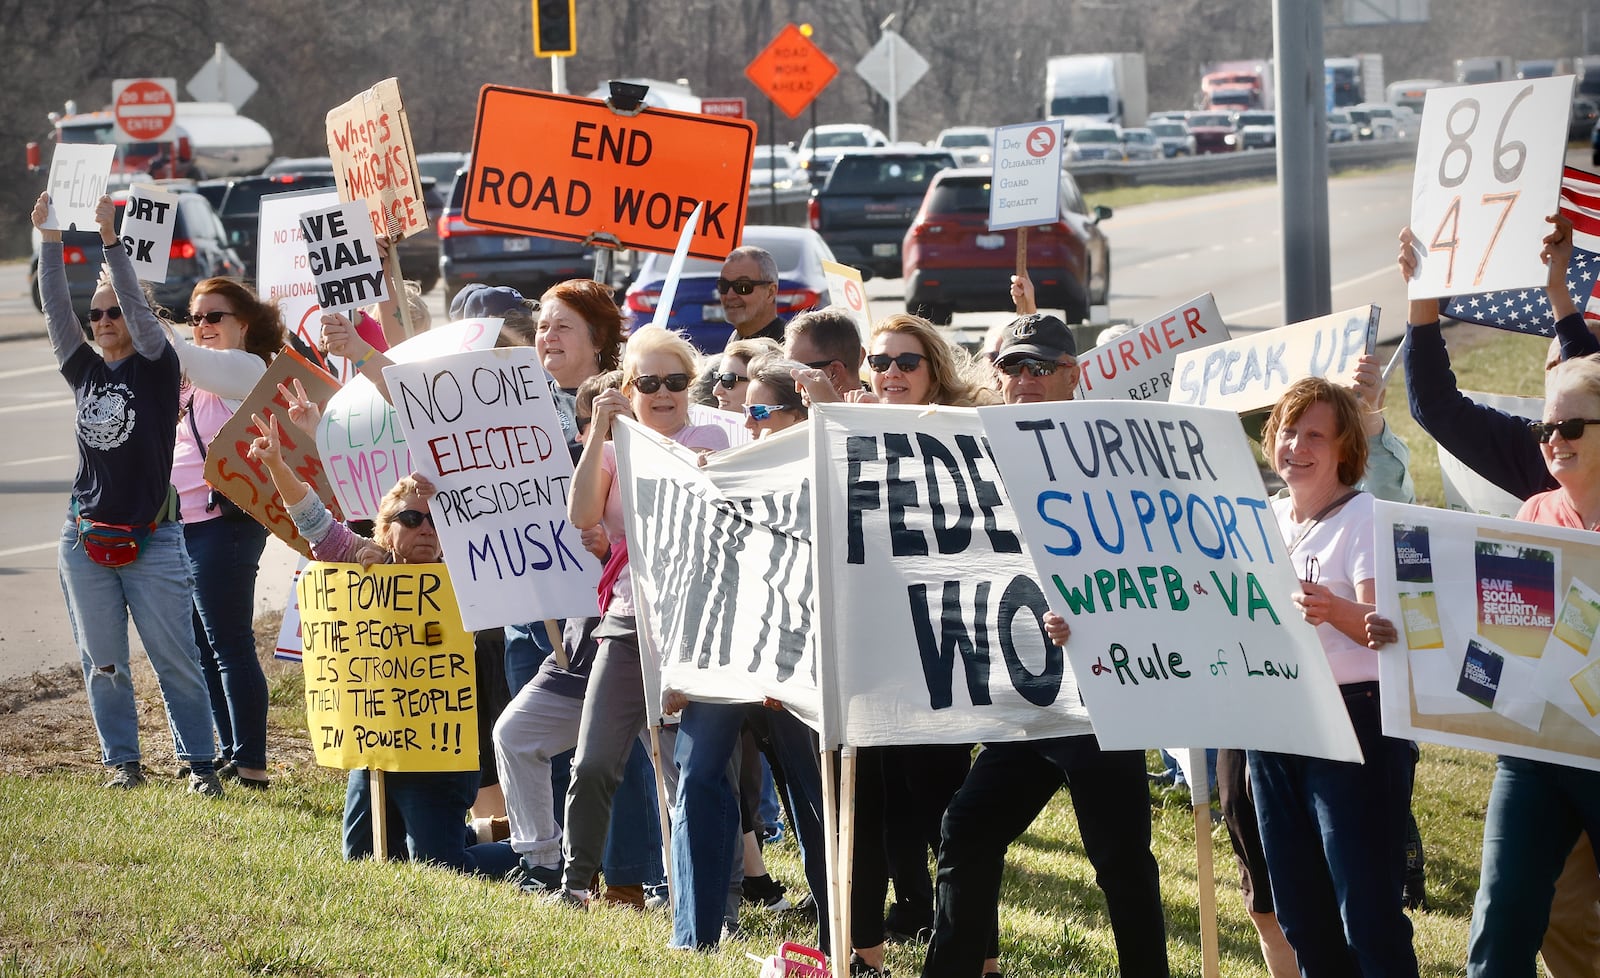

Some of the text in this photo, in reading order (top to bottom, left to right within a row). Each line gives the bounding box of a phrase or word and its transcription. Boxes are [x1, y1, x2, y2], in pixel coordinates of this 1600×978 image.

[774, 47, 808, 57] ROAD
[775, 65, 808, 74] WORK
[121, 90, 166, 103] DO NOT
[772, 81, 814, 92] AHEAD
[704, 103, 740, 114] WRONG
[127, 118, 163, 131] ENTER
[1438, 84, 1534, 188] 86
[352, 146, 370, 164] the
[571, 121, 652, 166] END
[1001, 158, 1047, 169] OLIGARCHY
[1000, 178, 1029, 189] GUARD
[478, 166, 729, 240] ROAD WORK
[999, 197, 1039, 209] EQUALITY
[274, 228, 308, 244] NO TA
[1428, 190, 1522, 288] 47
[294, 255, 309, 269] FO
[1079, 306, 1207, 391] TURNER
[1180, 317, 1369, 405] SPEAK UP
[399, 365, 539, 430] NO ONE
[1128, 368, 1174, 400] REPR
[428, 425, 552, 477] ELECTED
[1015, 418, 1218, 481] TURNER
[435, 475, 570, 527] PRESIDENT
[846, 432, 1023, 565] FEDE
[1037, 489, 1275, 564] SUPPORT
[468, 520, 583, 581] MUSK
[301, 568, 338, 612] THE
[346, 569, 441, 616] POWER
[1051, 565, 1189, 616] WPAFB
[1209, 570, 1281, 625] VA
[1480, 578, 1513, 592] SAVE
[1482, 590, 1525, 604] SOCIAL
[1483, 602, 1538, 616] SECURITY
[1484, 614, 1492, 625] &
[356, 619, 443, 650] PEOPLE
[907, 574, 1085, 710] WO
[316, 653, 470, 682] IS STRONGER
[1210, 648, 1228, 676] of
[1239, 641, 1299, 680] Law
[308, 686, 474, 719] THEN THE PEOPLE
[321, 725, 344, 750] IN
[353, 724, 422, 754] POWER
